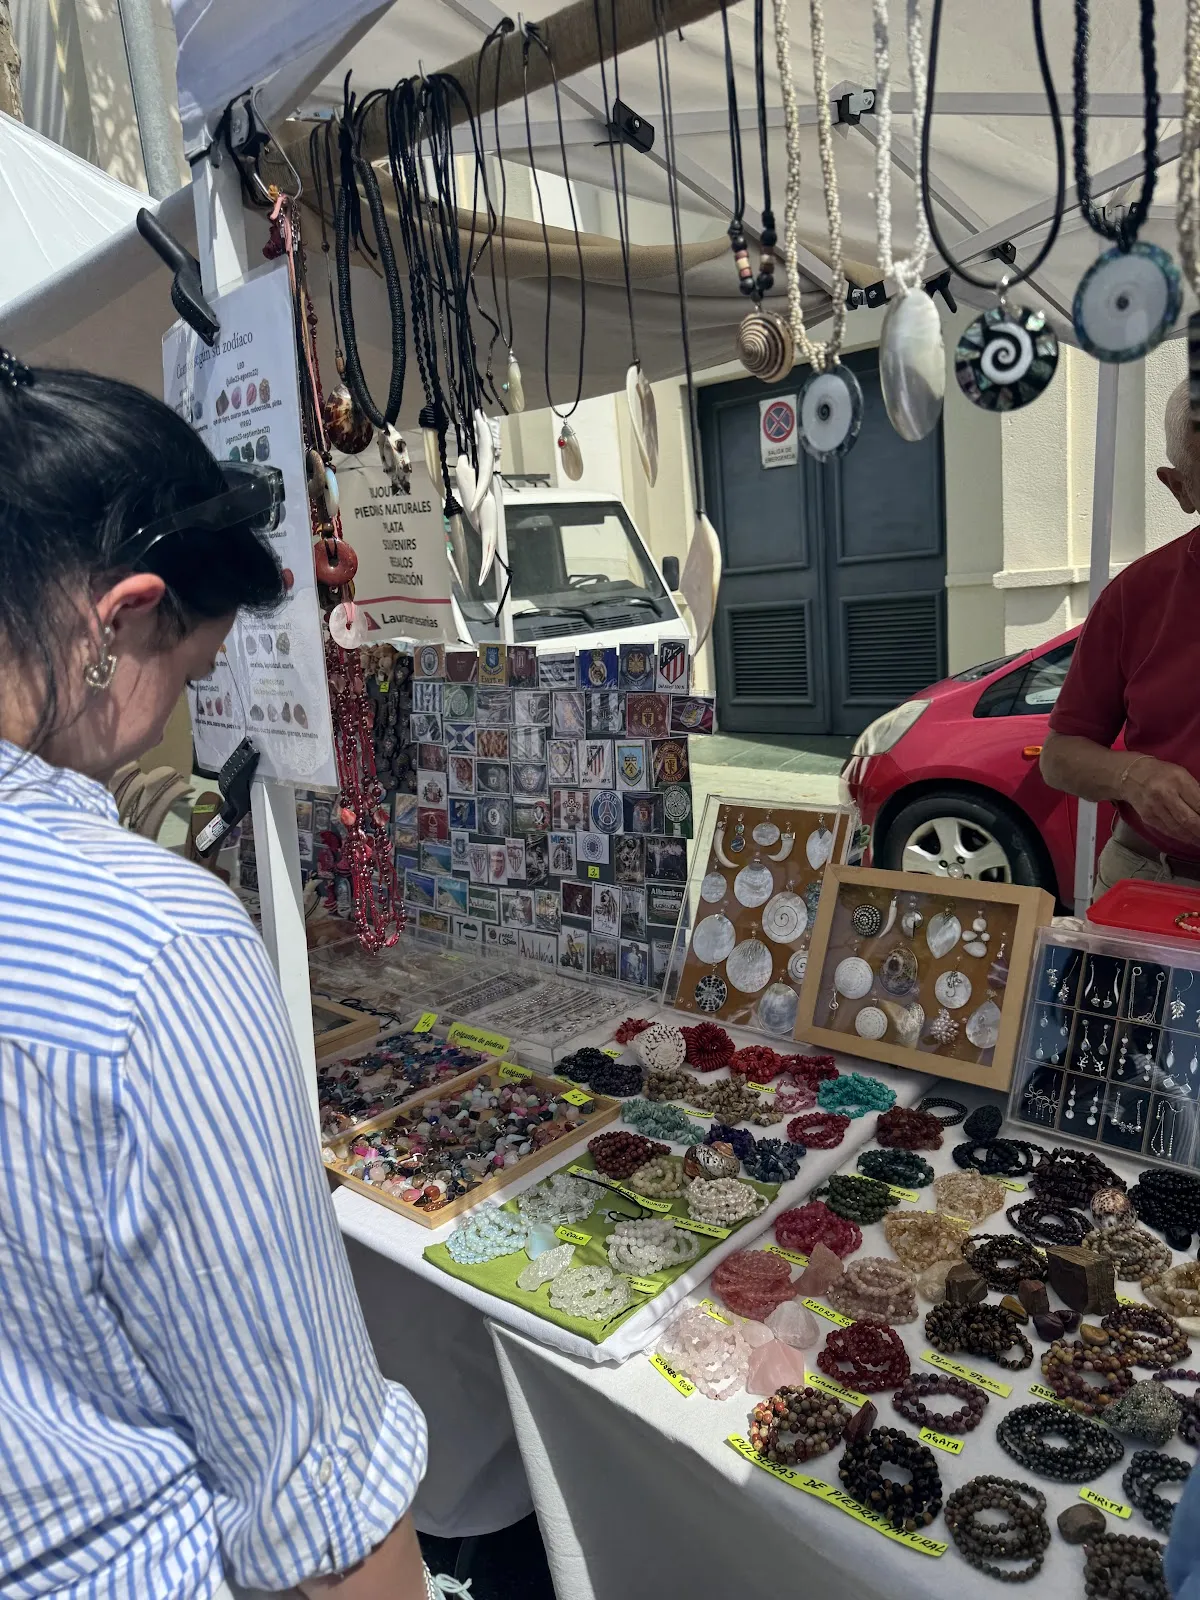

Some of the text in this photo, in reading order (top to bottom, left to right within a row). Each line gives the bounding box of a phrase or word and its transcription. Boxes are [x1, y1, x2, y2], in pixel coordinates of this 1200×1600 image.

[222, 331, 253, 354] zodíaco
[385, 500, 432, 515] NATURALES
[597, 793, 617, 805] PARIS
[453, 1029, 505, 1050] Colgantes de piedras
[808, 1374, 860, 1402] Cornalina
[731, 1437, 948, 1553] PULSERAS DE PIEDRA NATURAL
